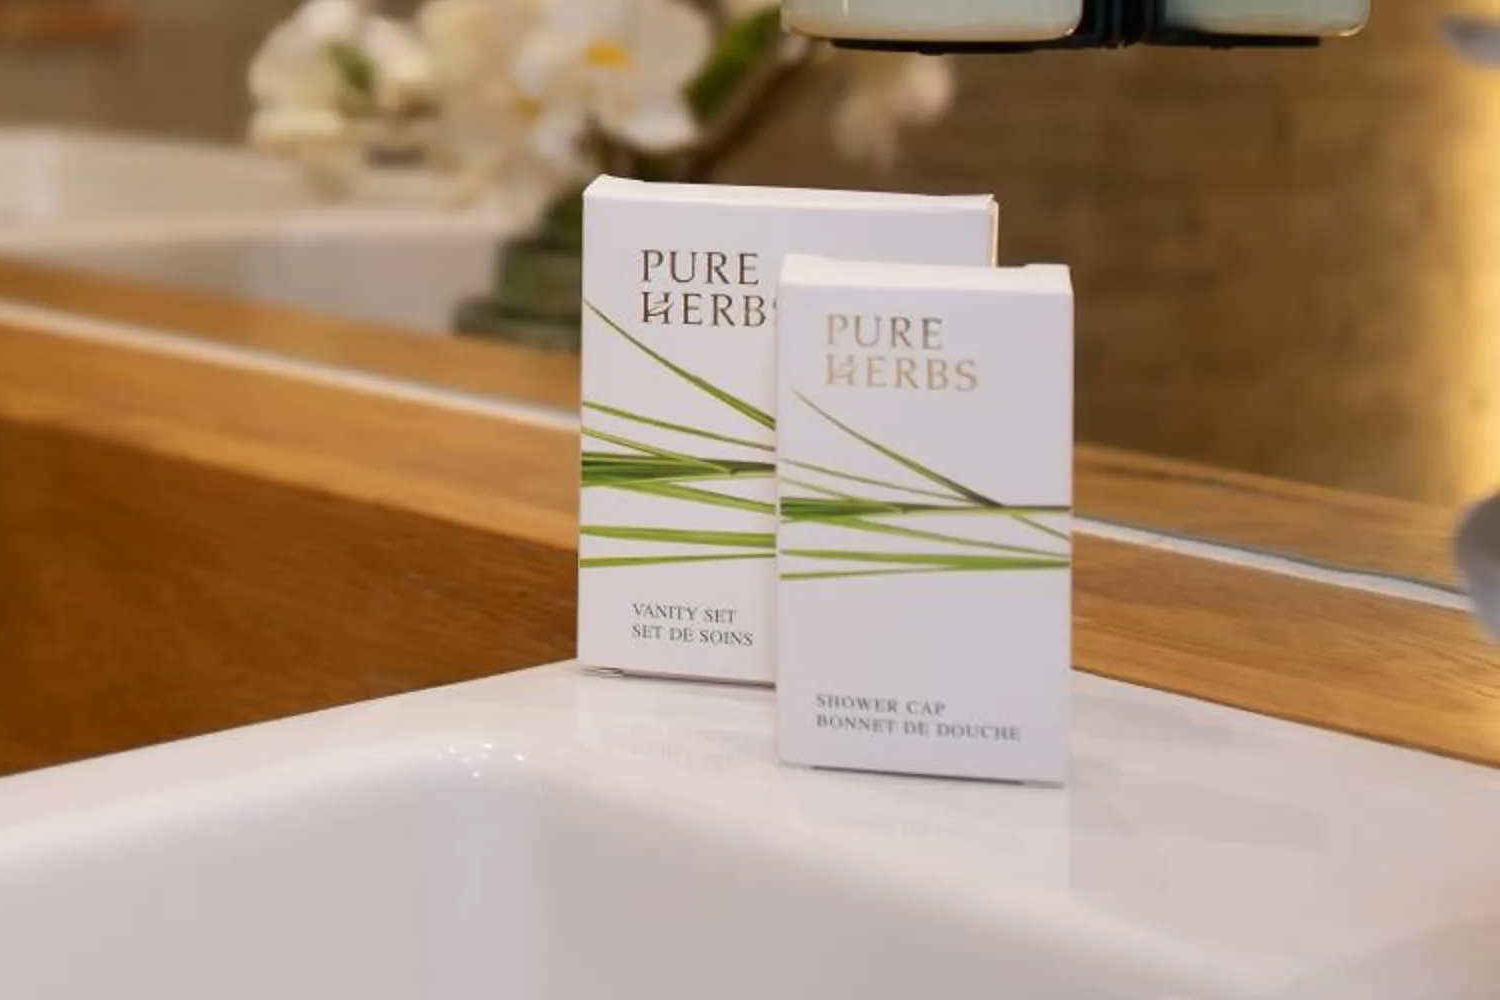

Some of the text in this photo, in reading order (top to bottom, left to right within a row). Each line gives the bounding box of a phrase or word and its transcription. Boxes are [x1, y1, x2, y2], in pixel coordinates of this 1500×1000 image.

[641, 249, 759, 286] PURE
[641, 291, 776, 327] HERB
[826, 313, 943, 350] PURE
[825, 353, 979, 392] HERBS
[631, 603, 738, 624] VANITY SET
[631, 624, 754, 647] SET DE SOINS
[815, 693, 946, 716] SHOWER CAP
[815, 713, 1021, 742] BONNET DE DOUCHE
